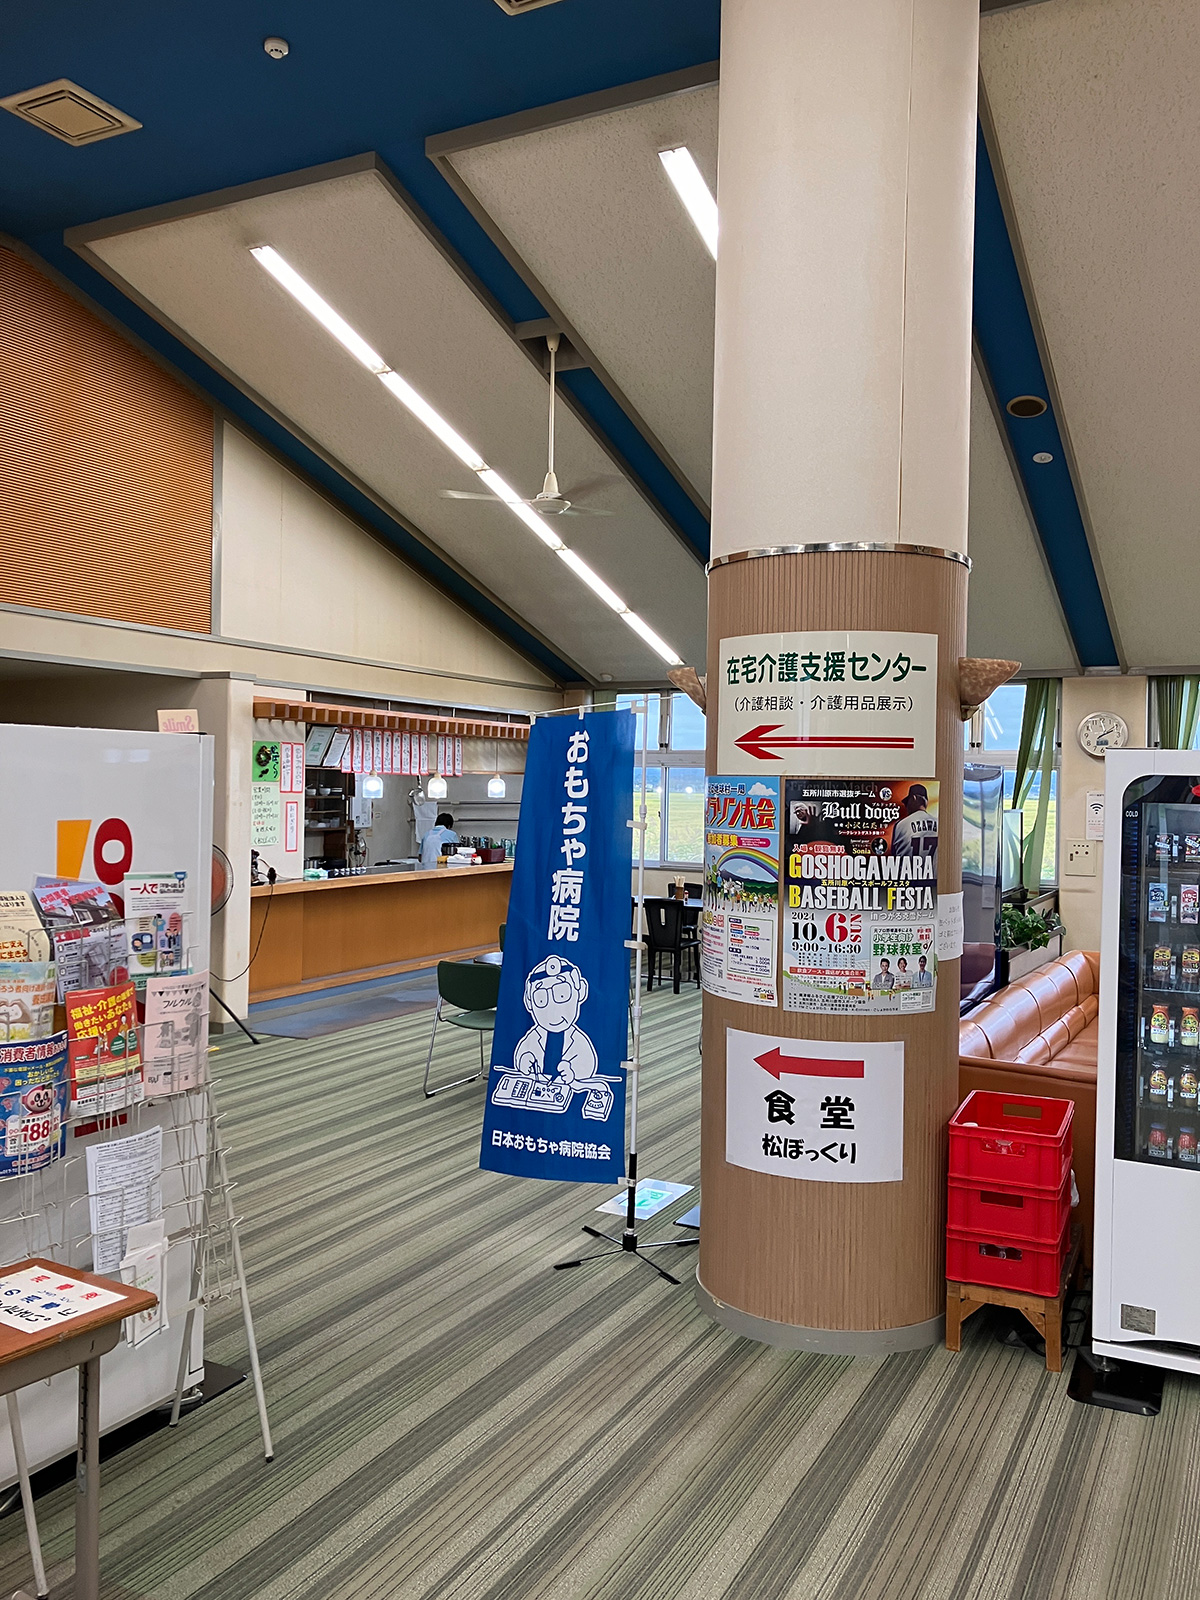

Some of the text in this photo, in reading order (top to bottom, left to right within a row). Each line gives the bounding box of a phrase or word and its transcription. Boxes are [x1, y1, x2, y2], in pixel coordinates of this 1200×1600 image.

[727, 651, 927, 685] 在宅介護支援センター
[734, 695, 914, 712] (介護相談・介護用品展示)
[802, 789, 876, 798] 五所川原市選抜チーム
[822, 802, 901, 823] Bull dogs
[547, 730, 590, 942] おもちゃ病院
[911, 837, 938, 856] 17
[789, 854, 934, 881] GOSHOGAWARA
[130, 883, 159, 895] 一人で
[821, 879, 910, 887] 五所川原ベースボールフェスタ
[789, 885, 934, 911] BASEBALL FESTA
[791, 912, 815, 921] 2024
[870, 911, 878, 921] in
[849, 913, 862, 943] SUN
[873, 933, 915, 943] 小学生向け
[872, 943, 923, 957] 野球教室
[764, 1089, 855, 1130] 食堂
[21, 1119, 50, 1143] 188
[491, 1129, 612, 1160] 日本おもちゃ病院協会
[761, 1133, 857, 1164] 松ぼっくり
